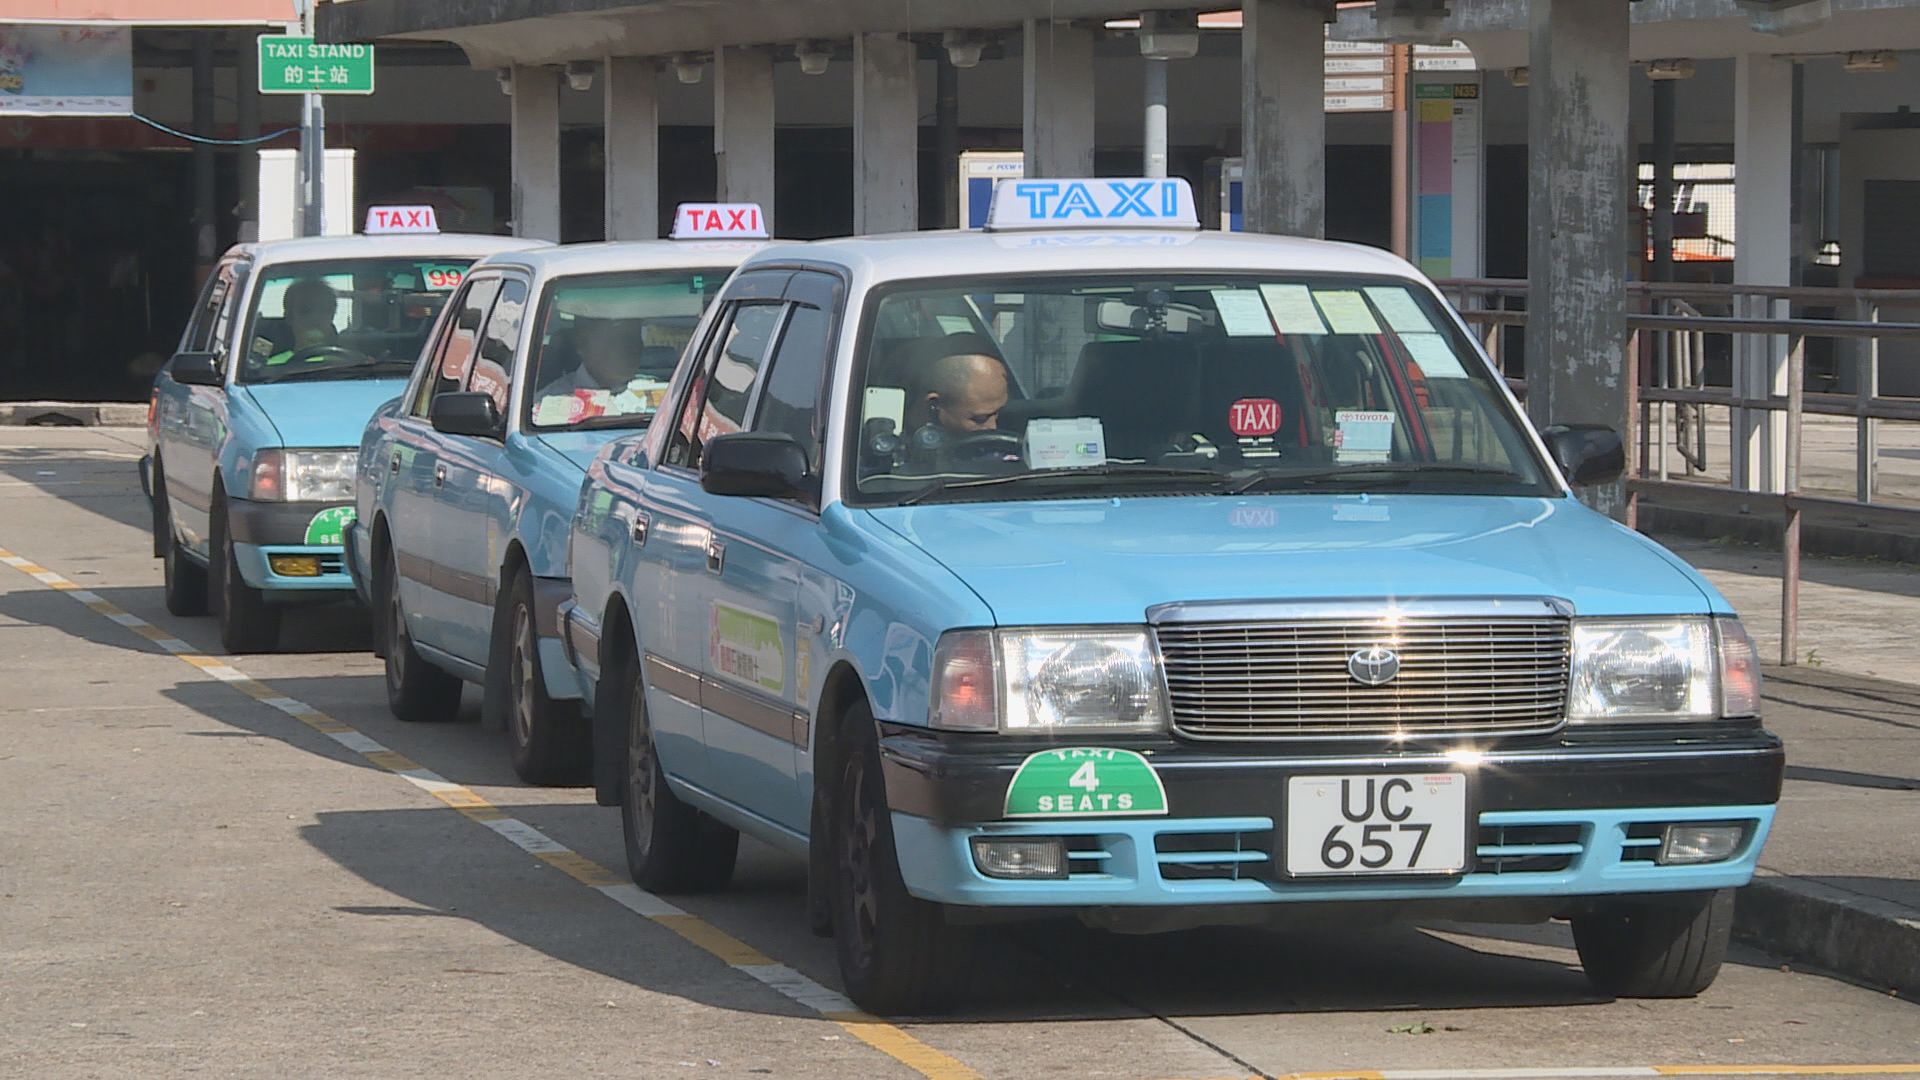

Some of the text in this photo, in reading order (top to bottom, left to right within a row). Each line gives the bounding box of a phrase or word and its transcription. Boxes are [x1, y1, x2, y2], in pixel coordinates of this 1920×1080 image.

[266, 44, 365, 58] TAXI STAND
[284, 65, 349, 84] 的士站
[1016, 182, 1177, 218] TAXI
[375, 210, 430, 227] TAXI
[687, 209, 757, 231] TAXI
[1233, 403, 1276, 431] TAXI
[1051, 749, 1117, 761] TAXI
[1069, 760, 1100, 792] 4
[1038, 793, 1133, 811] SEATS
[1341, 778, 1413, 823] UC
[1321, 823, 1432, 869] 657
